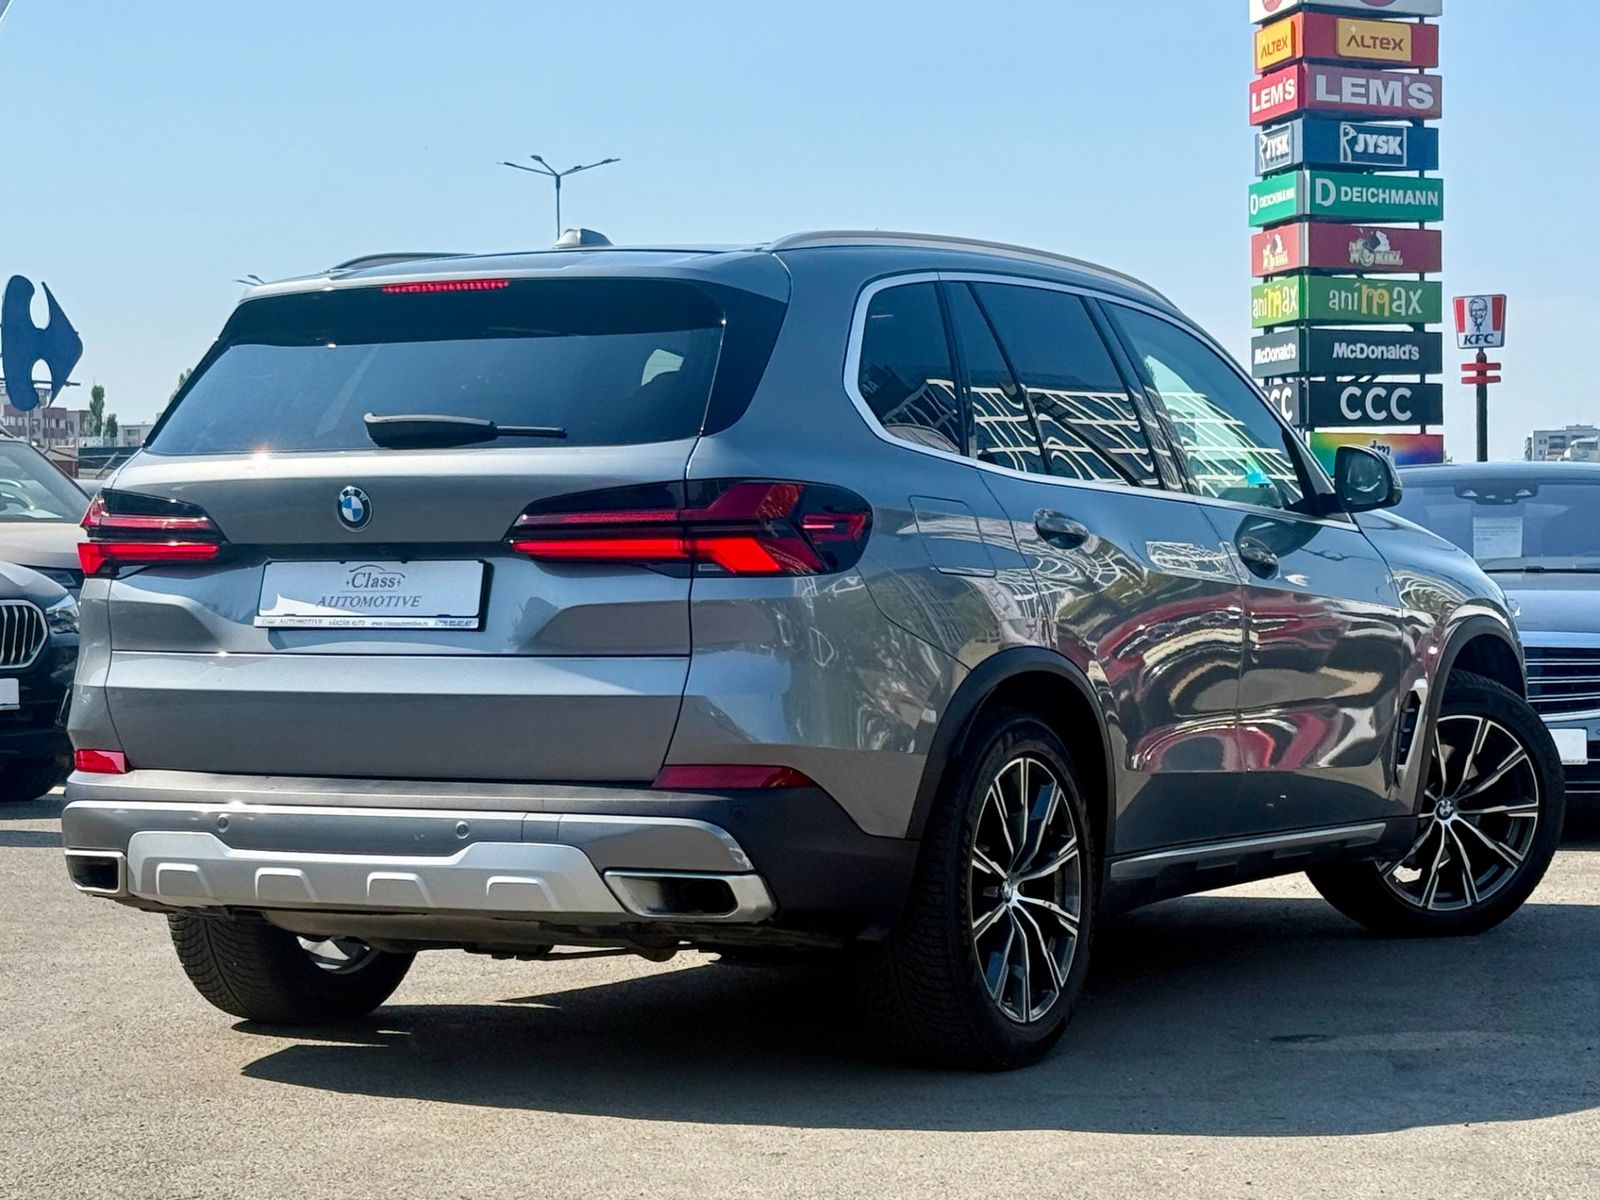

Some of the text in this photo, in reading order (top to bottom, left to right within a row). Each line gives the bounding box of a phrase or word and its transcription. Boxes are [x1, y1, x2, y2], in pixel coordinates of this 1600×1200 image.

[1251, 78, 1296, 113] LEM'S
[1315, 74, 1434, 110] LEM'S
[1265, 133, 1289, 160] JYSK
[1354, 134, 1403, 156] JYSK
[1340, 187, 1439, 206] DEICHMANN
[1463, 333, 1495, 345] KFC
[1254, 343, 1296, 365] McDonald's
[1332, 342, 1420, 361] McDonald's
[1262, 386, 1293, 421] CC
[1340, 386, 1412, 421] CCC
[351, 572, 396, 589] Class
[316, 594, 421, 608] AUTOMOTIVE
